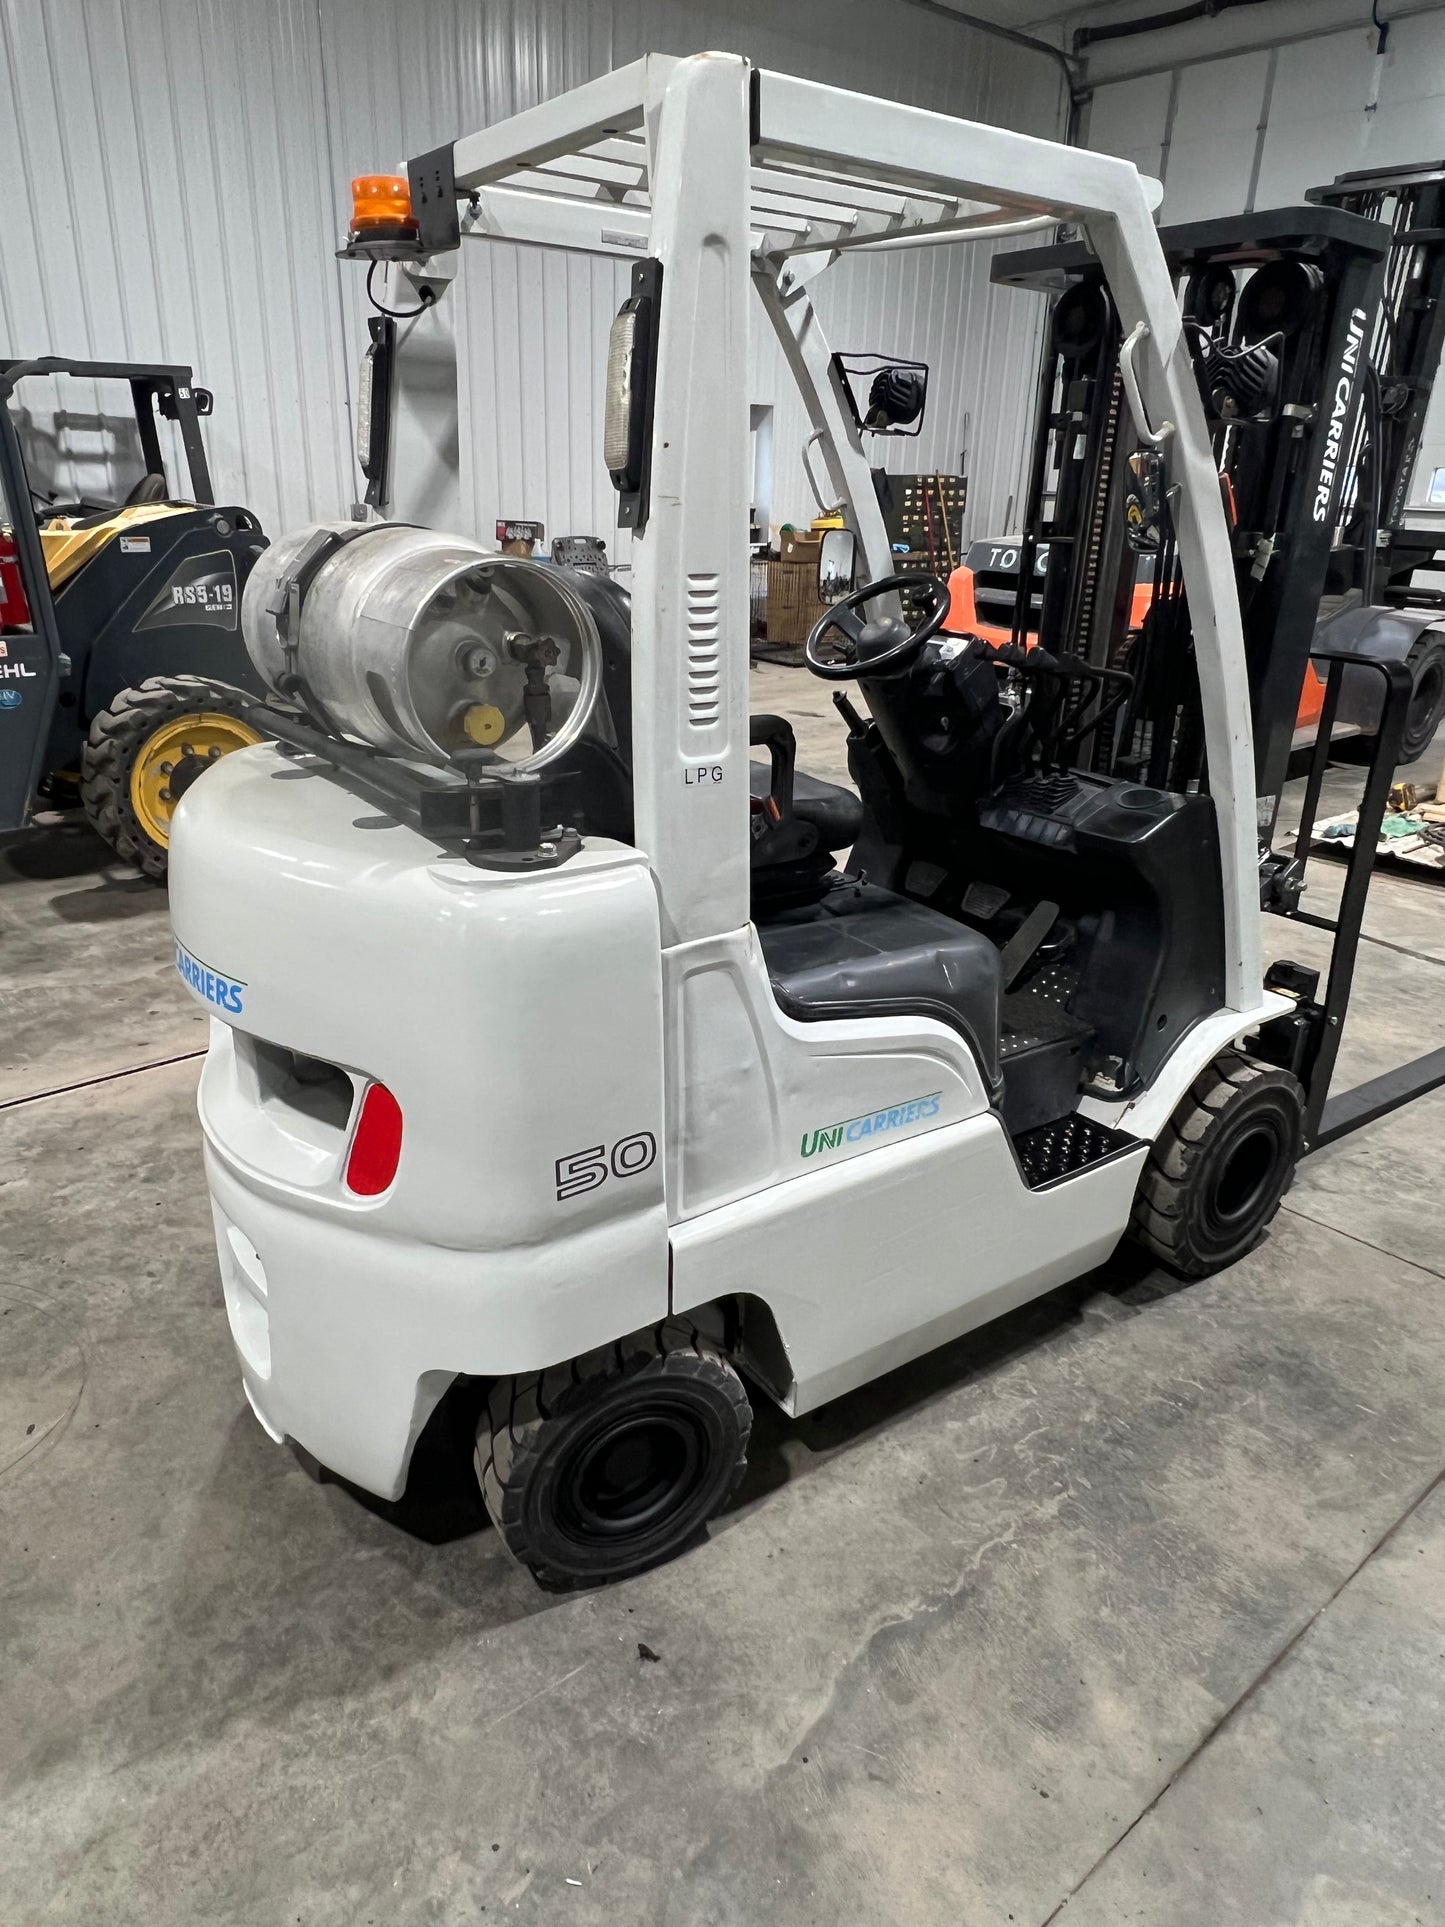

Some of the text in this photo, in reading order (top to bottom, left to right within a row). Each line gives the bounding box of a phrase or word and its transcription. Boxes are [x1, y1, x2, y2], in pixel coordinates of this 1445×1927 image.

[685, 765, 723, 785] LPG
[176, 944, 243, 1014] ARRIERS
[555, 1131, 656, 1202] 50
